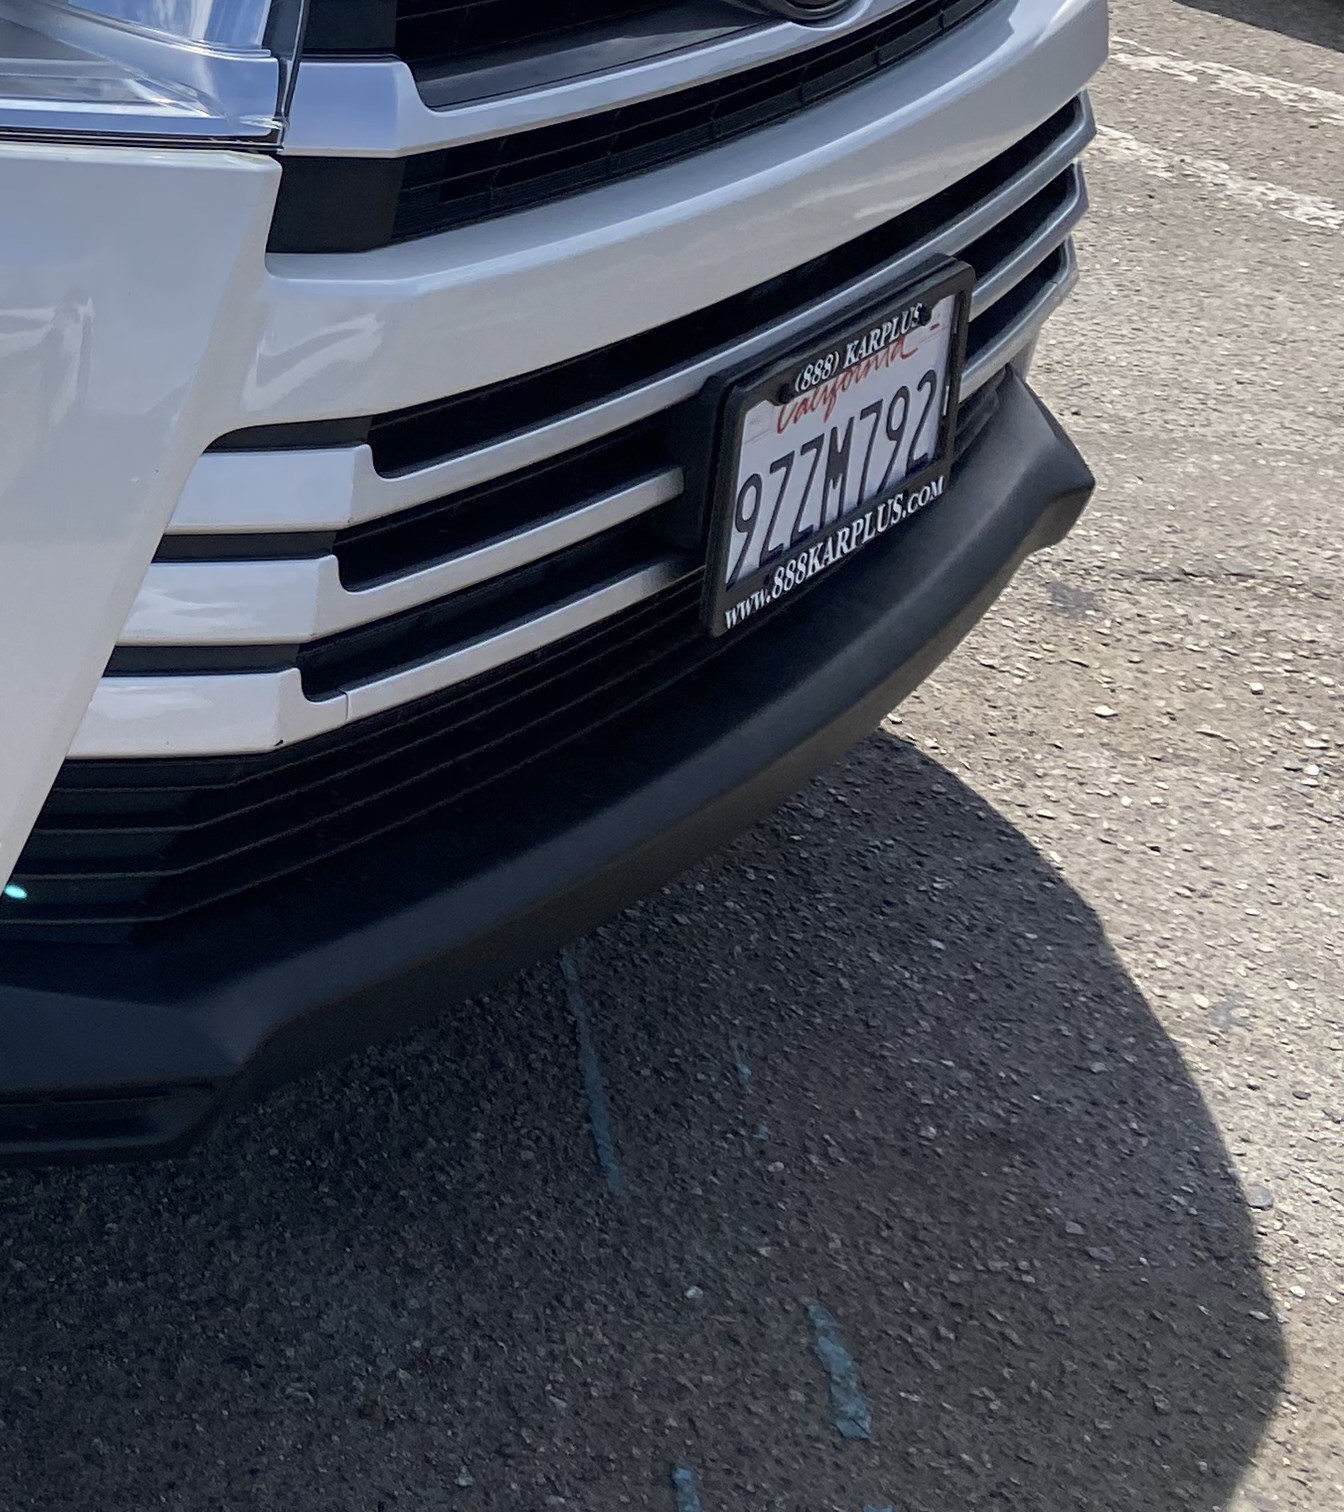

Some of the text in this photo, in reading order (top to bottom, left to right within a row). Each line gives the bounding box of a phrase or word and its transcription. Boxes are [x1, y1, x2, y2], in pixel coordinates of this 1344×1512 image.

[795, 302, 923, 392] (888) KARPLUS
[726, 369, 938, 592] 9ZZM792
